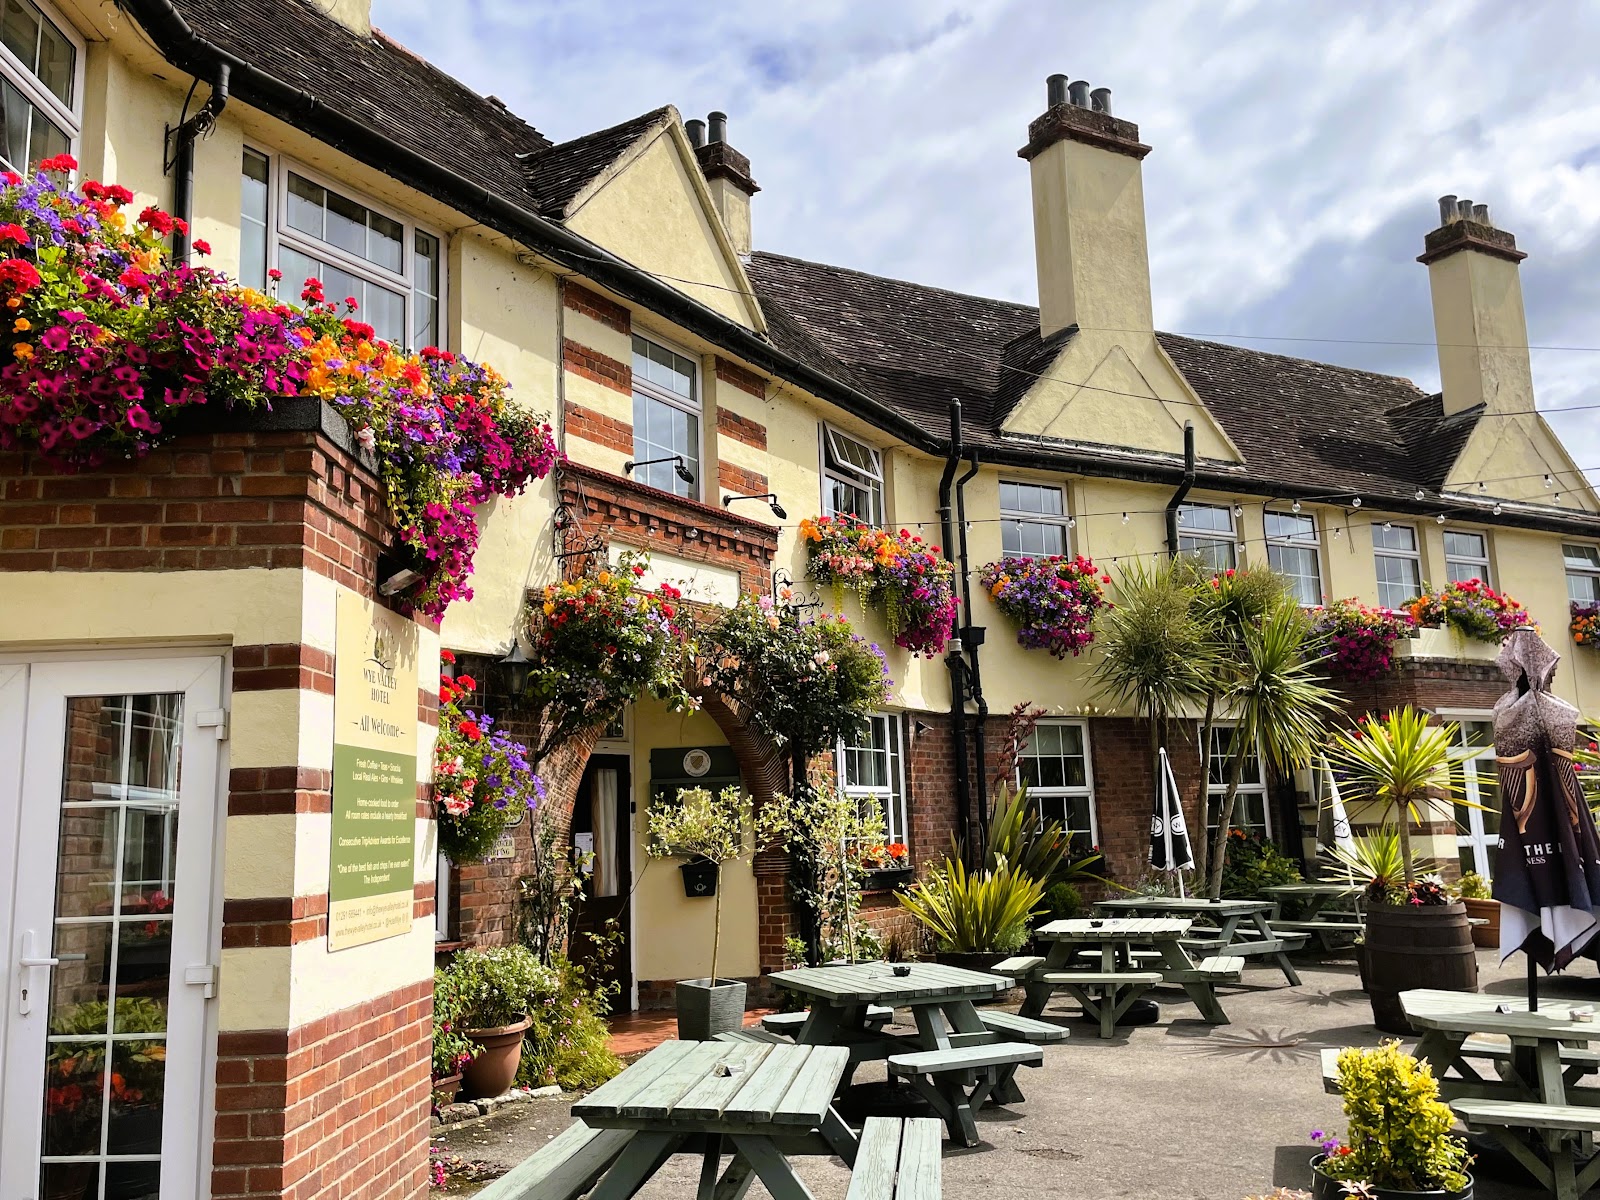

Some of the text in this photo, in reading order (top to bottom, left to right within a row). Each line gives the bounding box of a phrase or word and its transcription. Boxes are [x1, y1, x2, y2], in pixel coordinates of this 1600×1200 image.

[363, 668, 398, 690] WYE VALLEY
[371, 688, 390, 705] HOTEL
[360, 715, 400, 738] All Welcome
[356, 758, 401, 773] Fresh Coffee Teas Snacks
[352, 771, 362, 781] Local
[363, 772, 371, 782] Real
[371, 773, 379, 782] Ales
[380, 774, 389, 784] Gins
[357, 798, 380, 807] Home-cooked
[391, 800, 399, 808] order
[351, 812, 360, 820] room
[361, 811, 370, 820] rates
[370, 811, 381, 820] include
[385, 811, 394, 822] hearty
[394, 811, 408, 820] breakfast
[338, 836, 361, 847] Consecutive
[361, 836, 380, 847] TripAdvisor
[380, 835, 391, 845] Awards
[396, 835, 411, 844] Excellence
[1524, 843, 1553, 856] THE
[380, 861, 388, 871] chips
[370, 873, 391, 885] Independent
